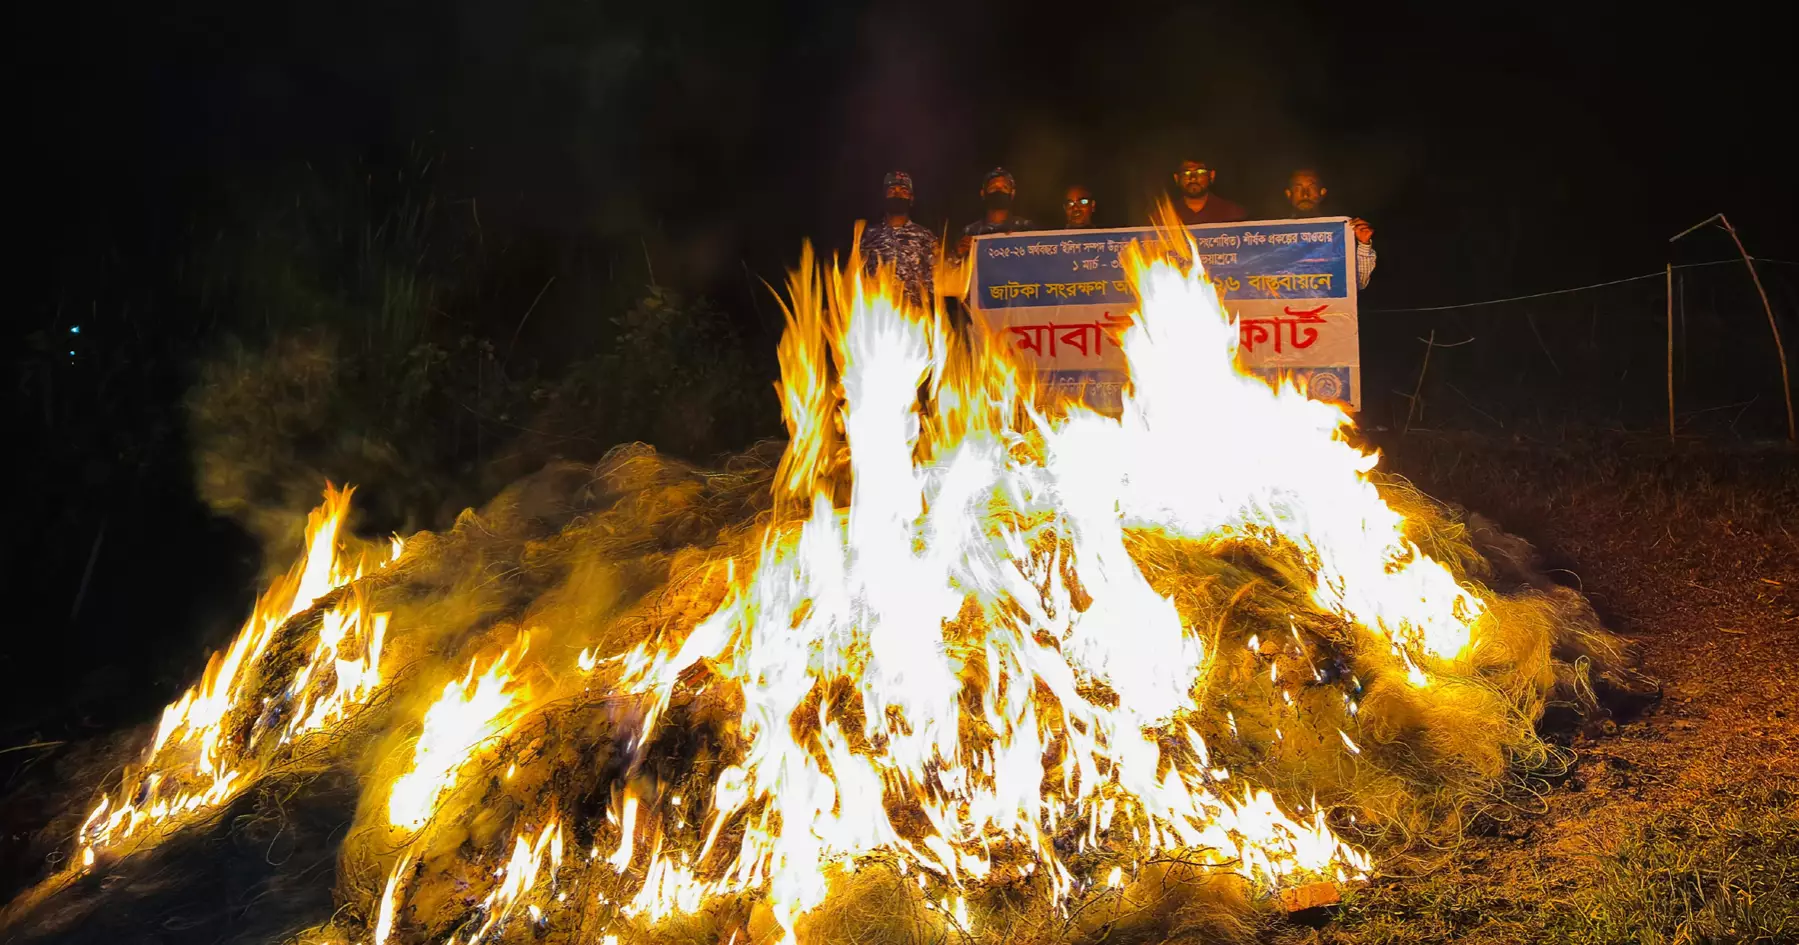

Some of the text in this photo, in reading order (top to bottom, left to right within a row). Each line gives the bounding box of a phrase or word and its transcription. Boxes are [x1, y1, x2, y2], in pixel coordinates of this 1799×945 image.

[1082, 256, 1100, 270] মার্চ
[989, 280, 1040, 300] জাটকা
[1045, 279, 1108, 299] সংরক্ষণ
[1248, 273, 1333, 292] বাস্তবায়নে
